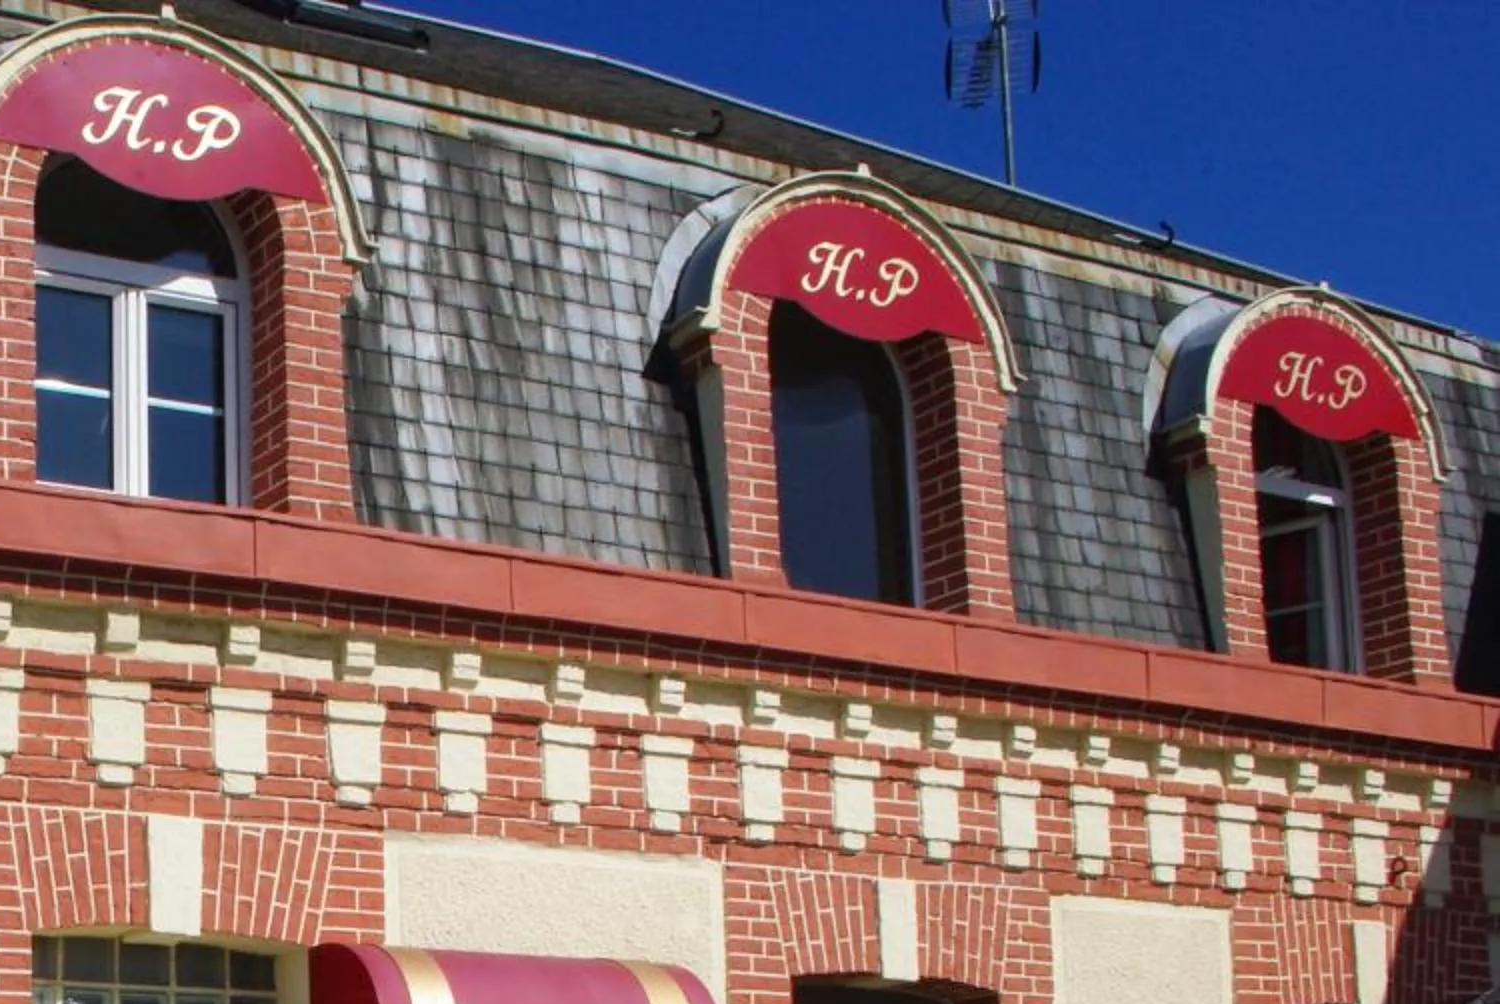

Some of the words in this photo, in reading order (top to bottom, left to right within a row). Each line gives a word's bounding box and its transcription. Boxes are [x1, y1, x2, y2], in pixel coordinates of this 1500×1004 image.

[80, 86, 242, 161] H.P
[801, 241, 919, 307] H.P
[1274, 351, 1367, 409] H.P
